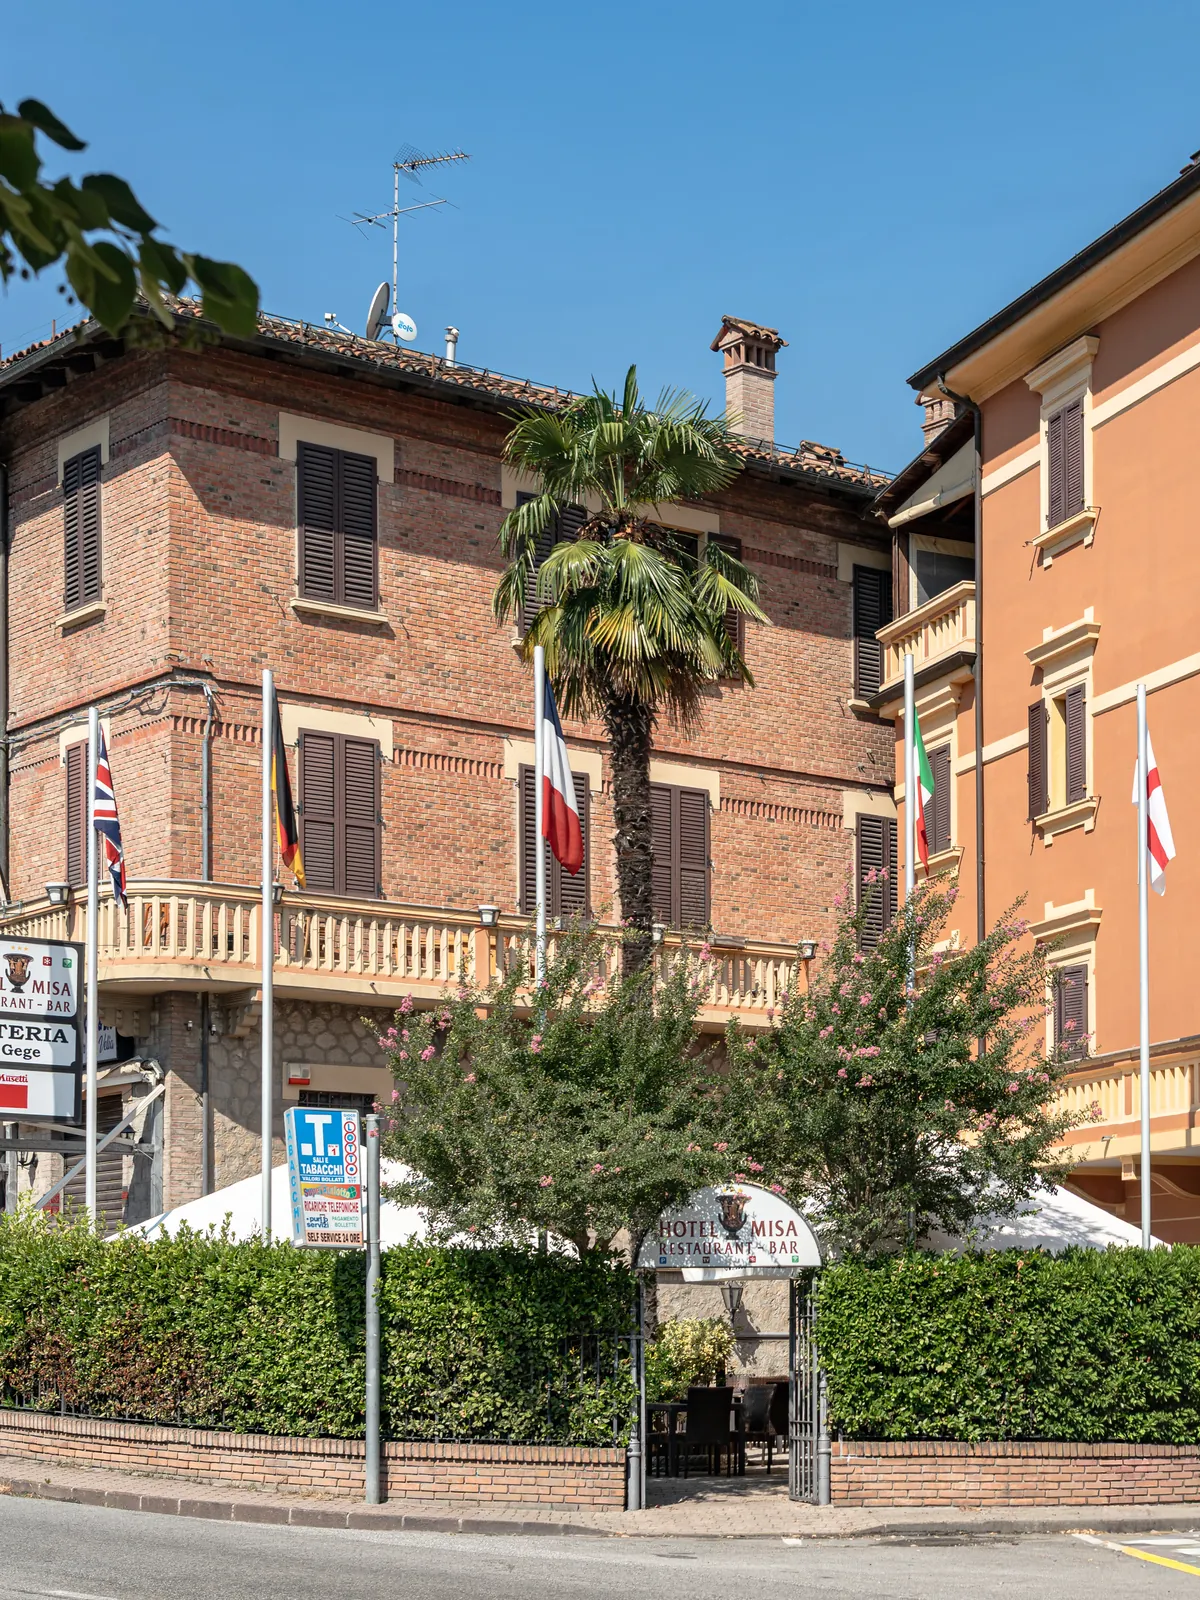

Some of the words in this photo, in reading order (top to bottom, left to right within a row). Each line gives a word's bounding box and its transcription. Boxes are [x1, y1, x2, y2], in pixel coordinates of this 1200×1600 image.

[32, 980, 71, 996] MISA
[1, 997, 34, 1009] RANT
[47, 1000, 71, 1012] BAR
[2, 1044, 41, 1060] Gege
[345, 1122, 357, 1174] LOTTO
[301, 1164, 343, 1175] TABACCHI
[304, 1201, 327, 1212] RICARICHE
[328, 1202, 359, 1213] TELEFONICHE
[660, 1220, 718, 1238] HOTEL
[751, 1220, 798, 1237] MISA
[307, 1232, 319, 1242] SELF
[320, 1233, 342, 1243] SERVICE
[343, 1233, 349, 1243] 24
[350, 1233, 361, 1243] ORE
[660, 1241, 752, 1255] RESTAURANT
[769, 1241, 798, 1254] BAR
